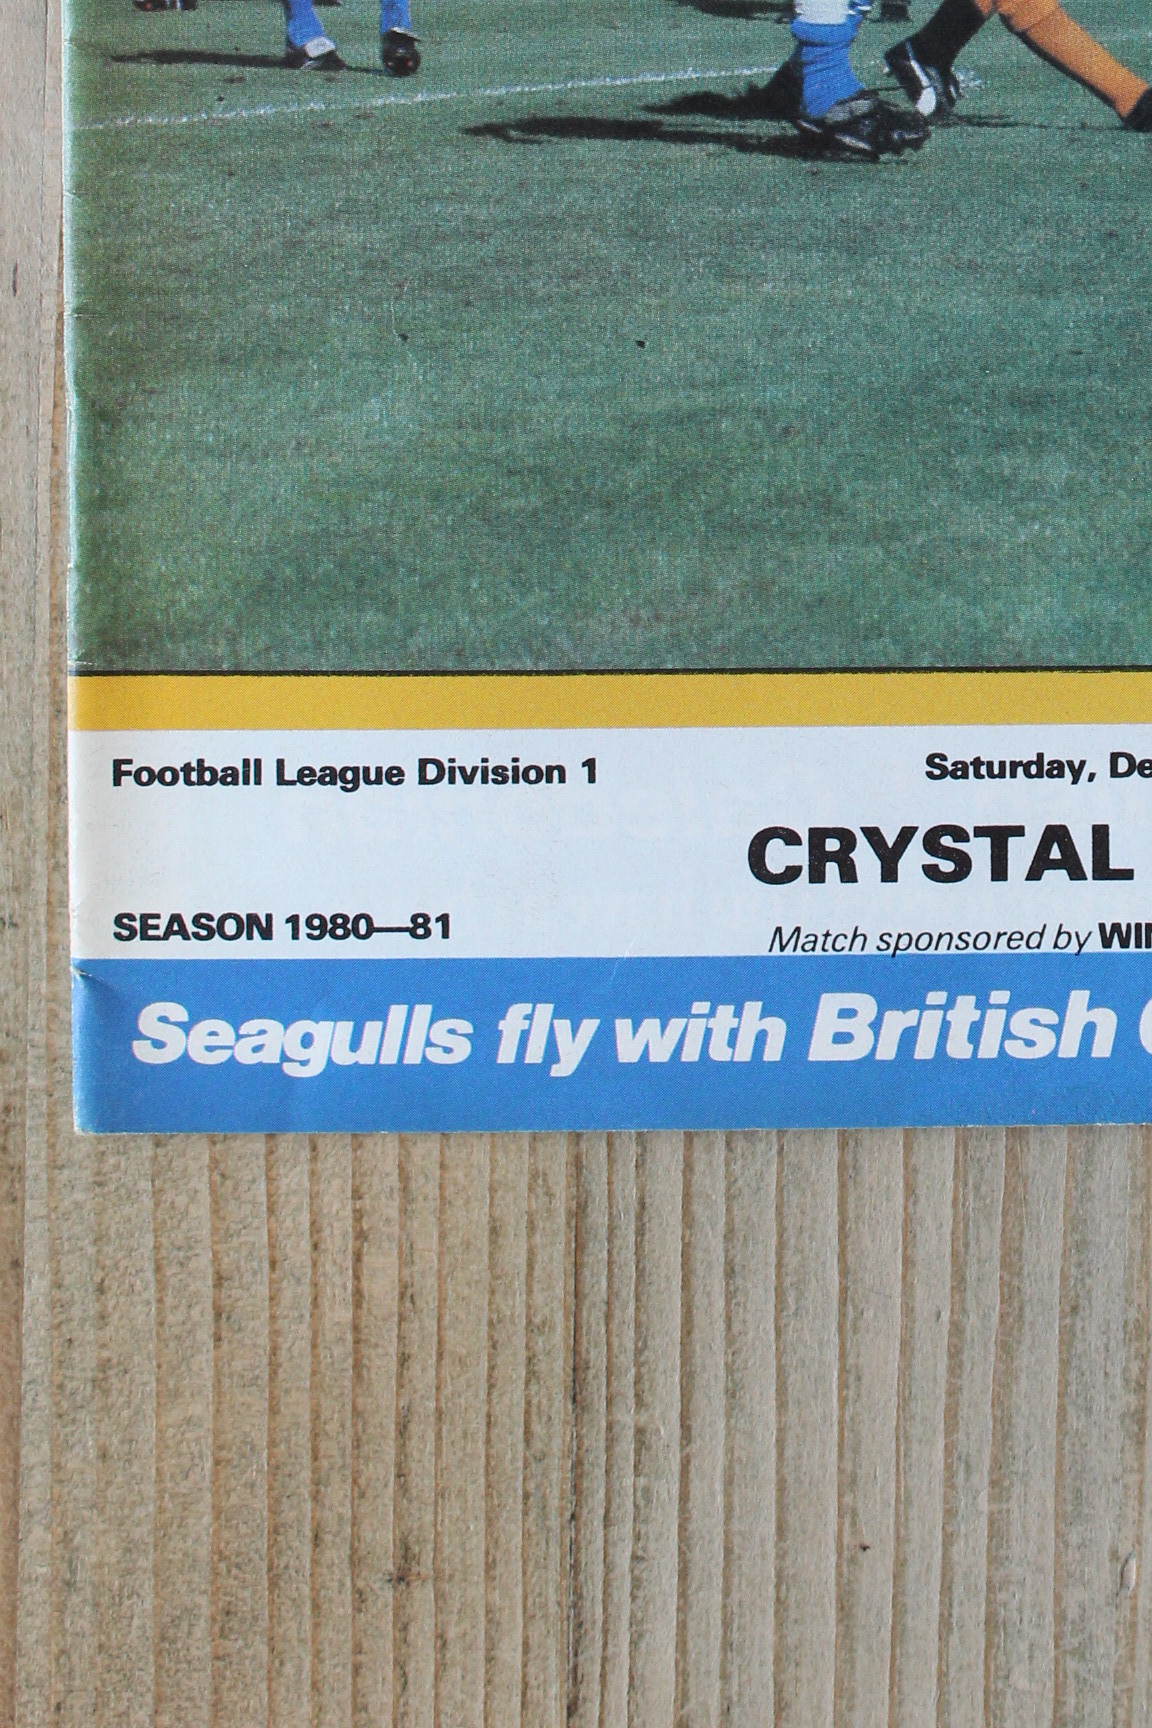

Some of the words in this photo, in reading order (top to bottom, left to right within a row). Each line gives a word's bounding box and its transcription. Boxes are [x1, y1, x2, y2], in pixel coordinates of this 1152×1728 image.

[112, 758, 262, 787] Football
[276, 758, 405, 793] League
[418, 757, 566, 786] Division
[582, 757, 597, 785] 1
[925, 750, 1097, 785] Saturday,
[747, 824, 1135, 886] CRYSTAL
[113, 912, 273, 942] SEASON
[768, 922, 868, 953] Match
[876, 923, 1047, 958] sponsored
[1052, 923, 1092, 956] by
[131, 1001, 474, 1079] Seagulls
[496, 1002, 601, 1078] fly
[614, 1000, 788, 1064] with
[807, 989, 1119, 1063] British
